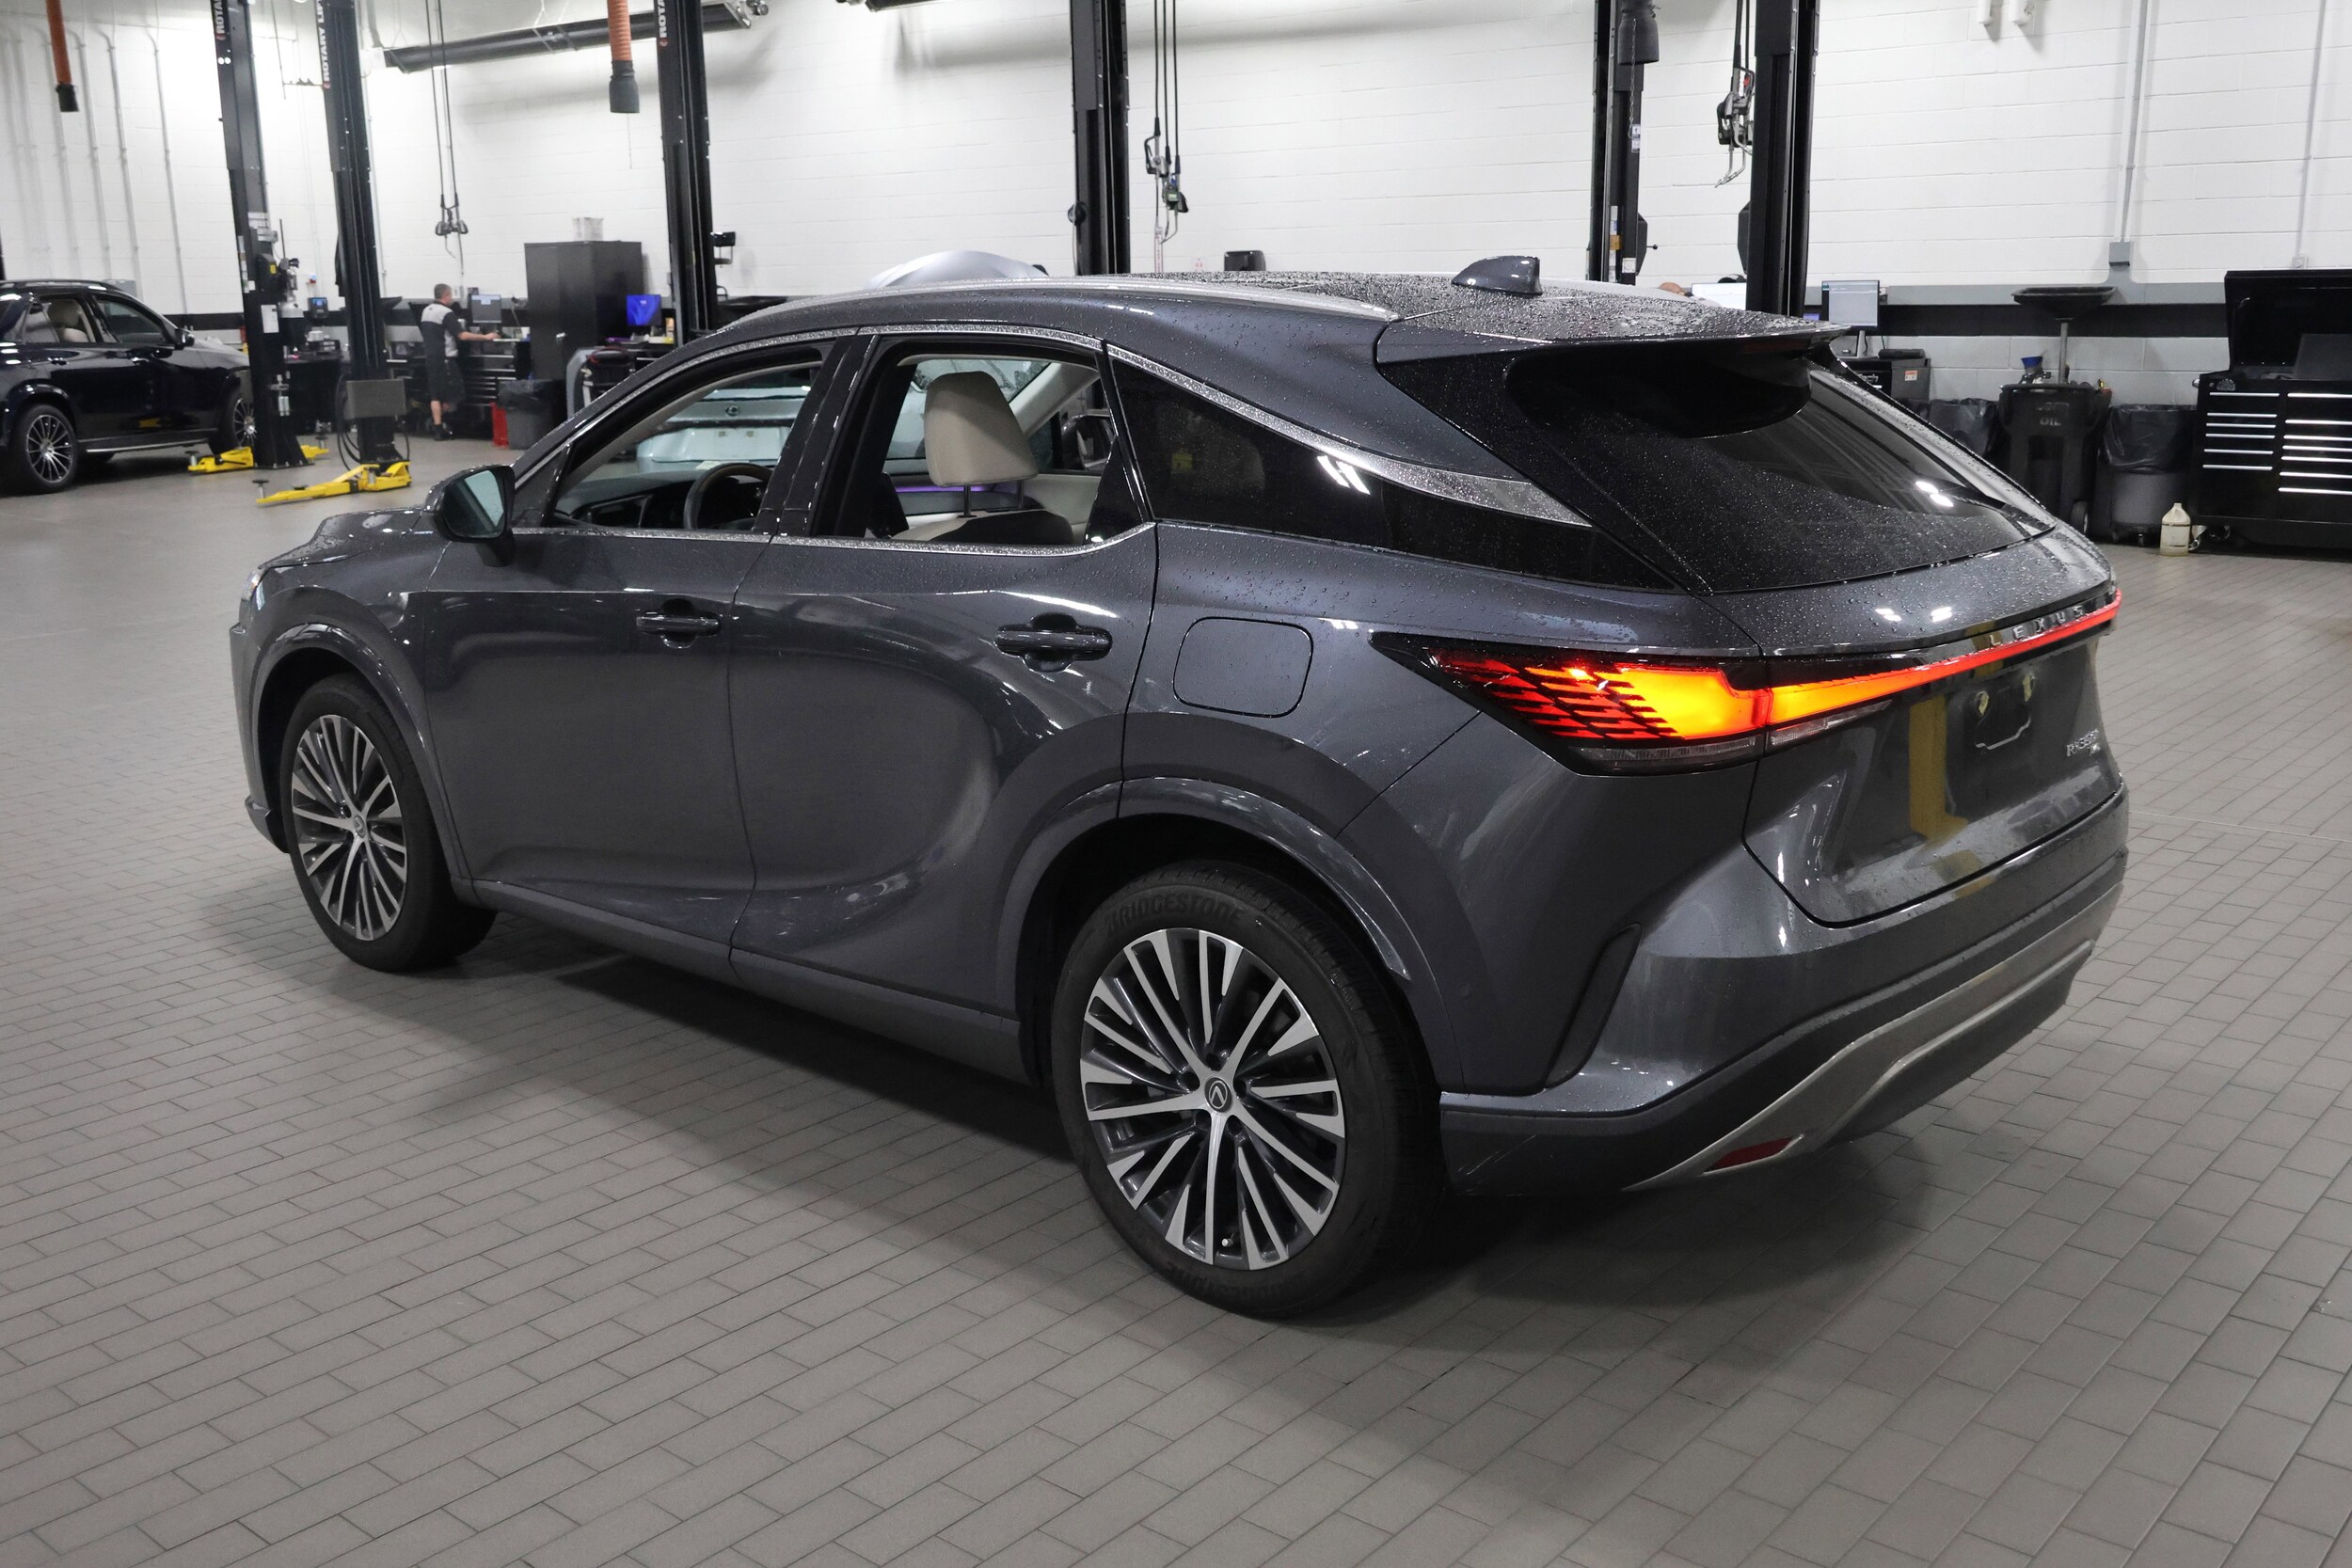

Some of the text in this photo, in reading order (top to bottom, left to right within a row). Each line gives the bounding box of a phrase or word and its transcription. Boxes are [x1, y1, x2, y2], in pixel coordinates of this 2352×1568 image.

[319, 27, 329, 81] ROTARY
[2040, 416, 2061, 426] OIL
[1989, 605, 2084, 646] LEXUS
[1104, 895, 1244, 932] BRIDGESTONE
